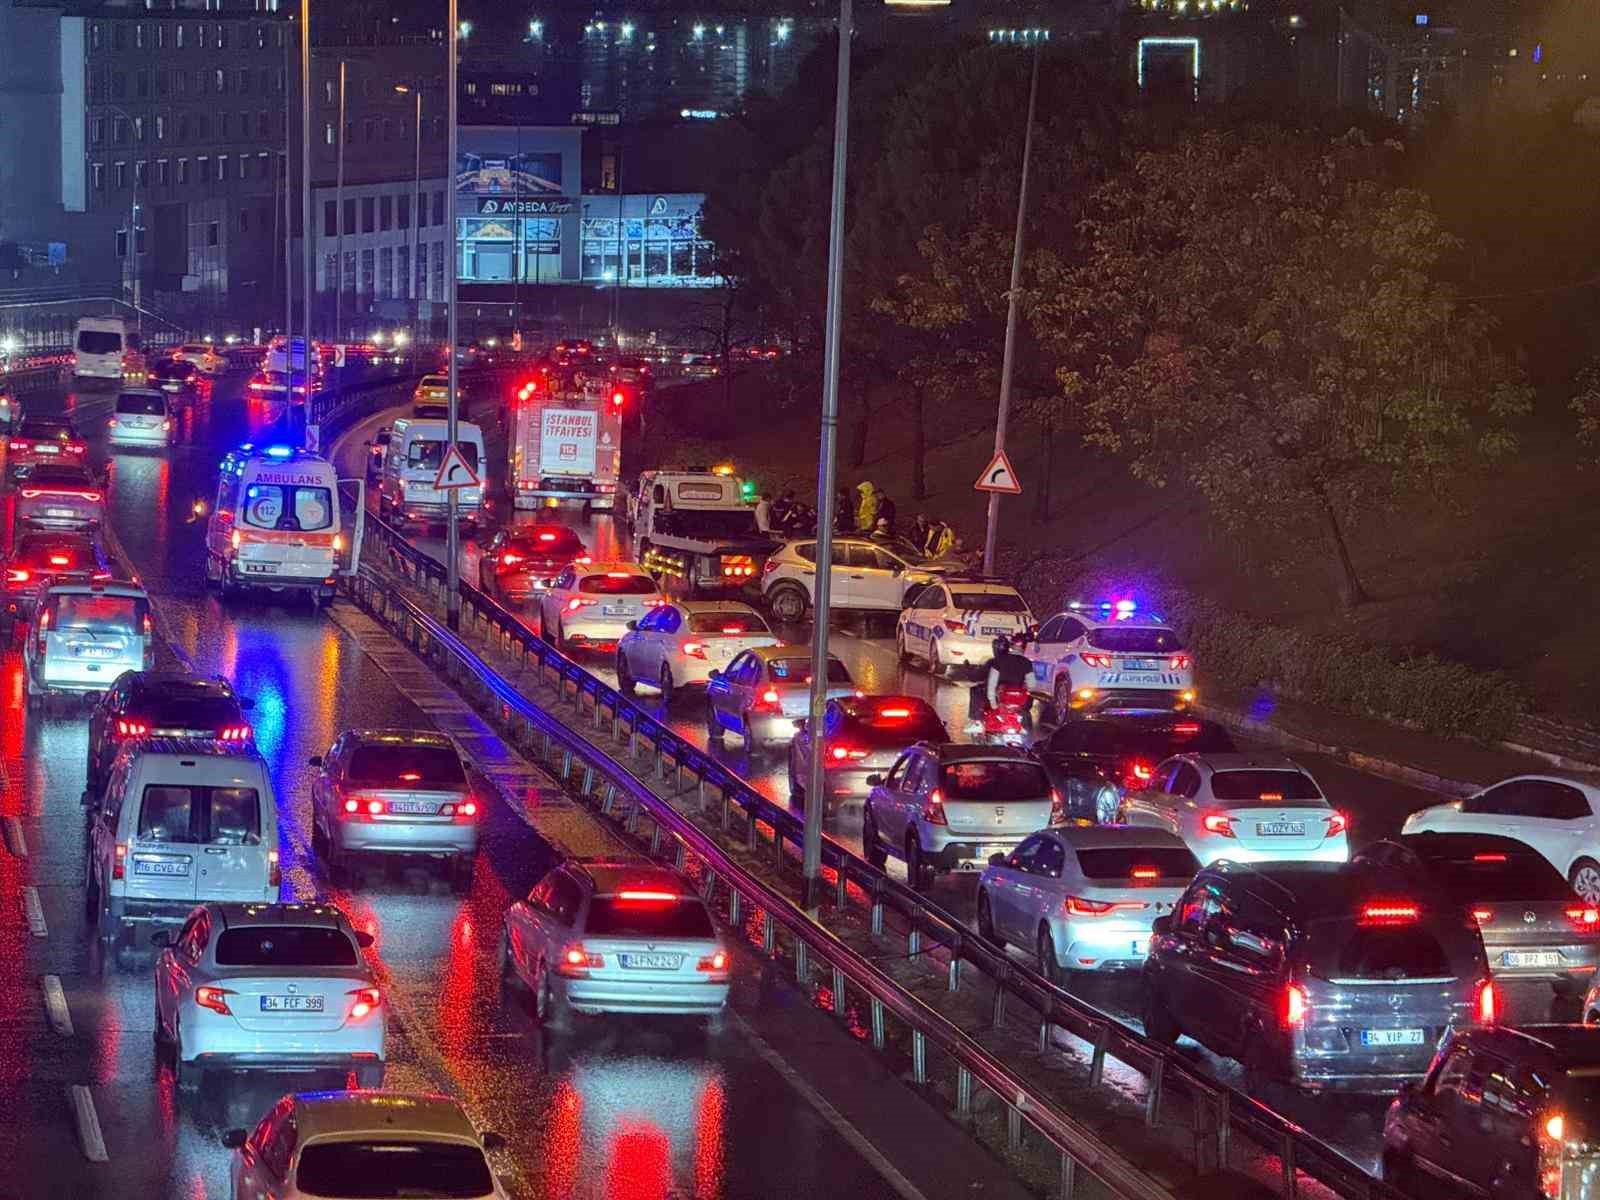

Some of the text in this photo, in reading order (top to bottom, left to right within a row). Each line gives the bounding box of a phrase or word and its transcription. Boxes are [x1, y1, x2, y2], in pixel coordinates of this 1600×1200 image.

[561, 444, 576, 456] 112
[256, 473, 322, 484] AMBULANS
[267, 998, 278, 1009] 34
